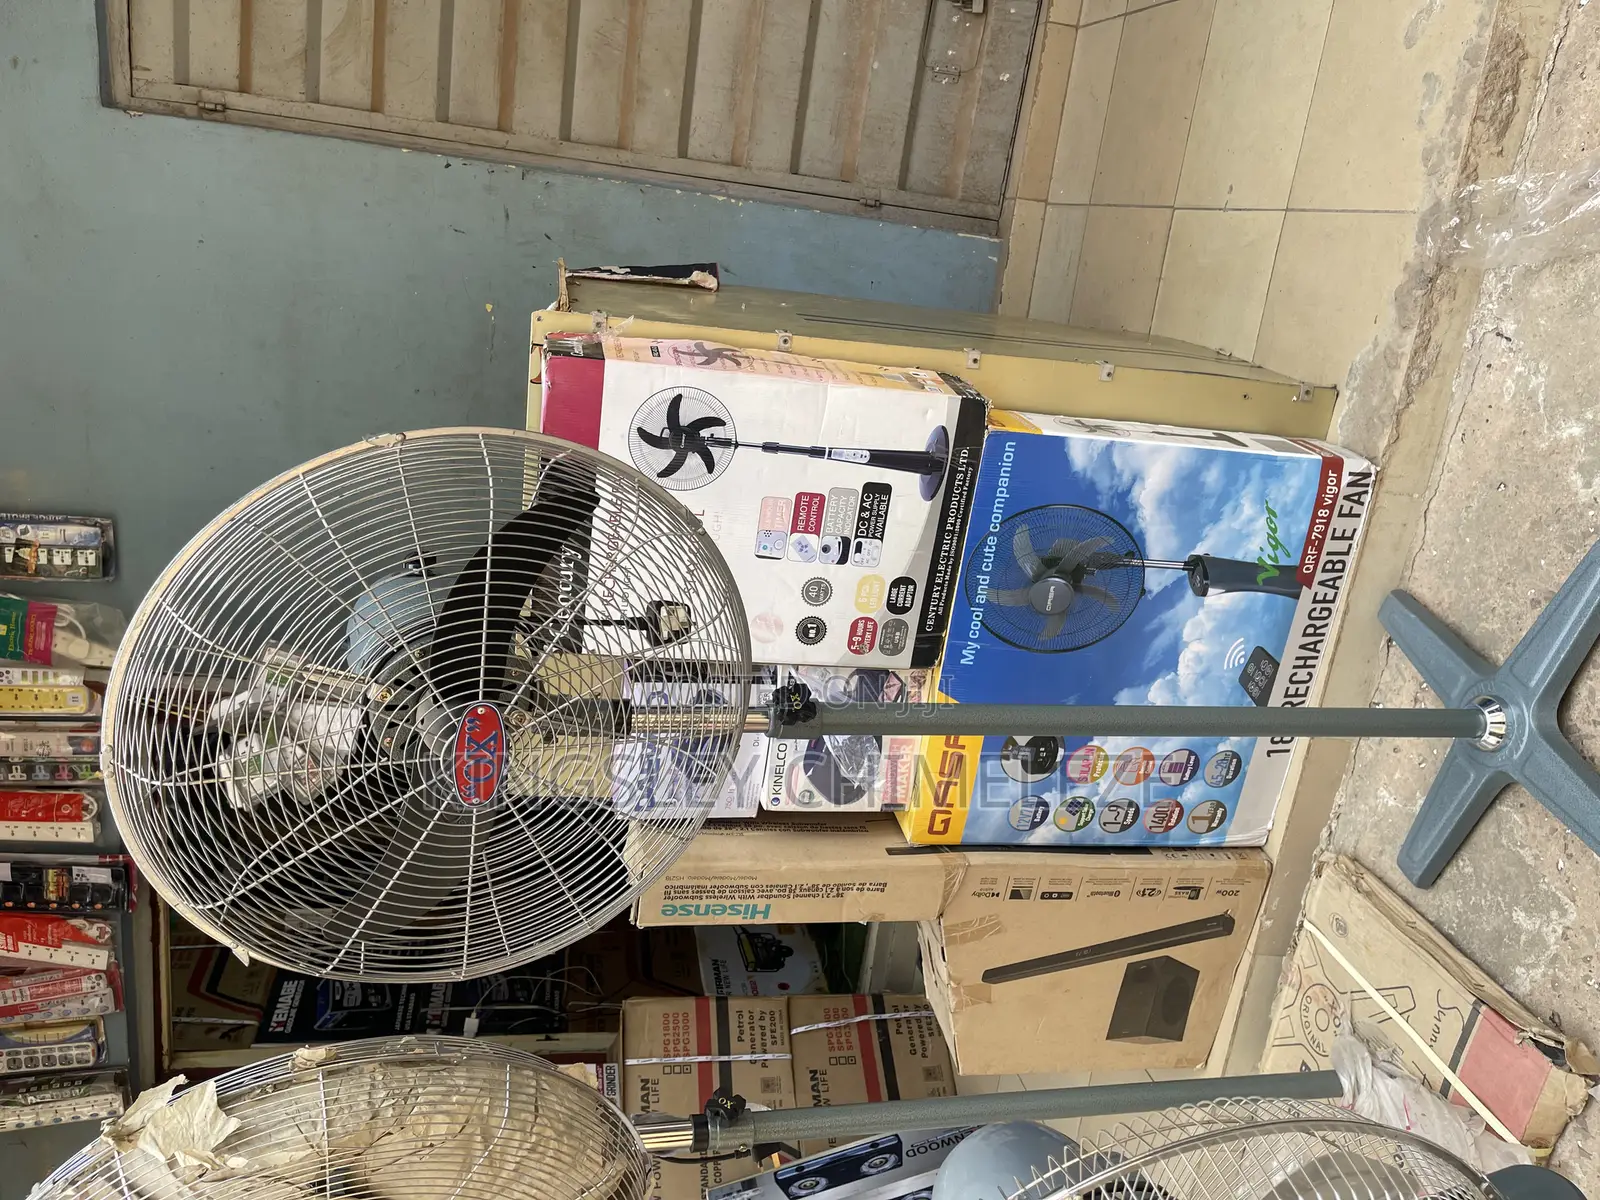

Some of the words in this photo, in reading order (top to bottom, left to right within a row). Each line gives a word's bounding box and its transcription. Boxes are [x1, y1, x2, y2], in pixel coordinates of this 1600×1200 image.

[961, 467, 973, 490] Factory
[989, 441, 1017, 532] companion
[797, 495, 810, 531] REMOTE
[808, 496, 820, 532] CONTROL
[825, 495, 838, 533] BATTERY
[835, 495, 847, 534] CAPACITY
[844, 496, 856, 535] INDICATOR
[860, 510, 870, 519] &
[863, 493, 873, 509] AC
[871, 493, 880, 516] SUPPLY
[957, 489, 967, 518] Certified
[857, 520, 868, 536] DC
[868, 516, 876, 537] POWER
[875, 494, 889, 539] AVAILABLE
[1302, 508, 1330, 575] QRF-7918
[1322, 469, 1340, 506] vigor
[925, 585, 942, 632] CENTURY
[935, 532, 952, 584] ELECTRIC
[946, 473, 964, 531] PRODUCTS
[957, 446, 970, 472] LTD.
[981, 535, 998, 572] cute
[1255, 499, 1291, 586] Vigor
[948, 557, 954, 565] by
[808, 586, 819, 598] 40
[818, 583, 826, 602] WATTS
[889, 587, 899, 604] LARGE
[896, 584, 907, 607] CURRENT
[904, 584, 915, 608] ADAPTOR
[939, 581, 949, 607] Products
[974, 574, 991, 605] and
[1046, 585, 1056, 612] QASA
[1280, 527, 1358, 708] RECHARGEABLE
[1336, 470, 1373, 519] FAN
[856, 620, 866, 636] HOURS
[866, 620, 875, 632] LIFE
[967, 606, 985, 640] cool
[960, 642, 980, 666] My
[771, 742, 788, 796] KINELCO
[897, 743, 913, 800] MAKER
[1183, 766, 1194, 781] Battery
[1188, 754, 1197, 766] Level
[1226, 758, 1238, 779] Duration
[1033, 806, 1046, 823] Battery
[1102, 803, 1126, 828] 1~9
[1123, 807, 1136, 825] Speeds
[1166, 807, 1181, 827] Rotation
[1191, 815, 1213, 825] 1
[1210, 807, 1225, 828] Warranty
[663, 890, 672, 898] fil
[757, 893, 791, 901] Soundbar
[971, 890, 992, 899] Dolby
[659, 903, 772, 920] Hisense
[711, 958, 726, 996] FIRMAN
[736, 1010, 745, 1043] Petrol
[758, 1010, 767, 1021] by
[769, 1010, 778, 1046] SFE200
[824, 1007, 836, 1053] SPG100
[832, 1007, 845, 1053] SPG200
[841, 1007, 854, 1052] SPG300
[892, 1004, 903, 1036] Petol
[903, 1004, 917, 1056] Generaor
[923, 1003, 935, 1037] SFE20
[1303, 994, 1328, 1055] ORIGINAL
[662, 1013, 671, 1058] SPG1800
[672, 1012, 681, 1057] SPG2500
[682, 1011, 690, 1057] SPG3000
[748, 1009, 757, 1065] Generator
[758, 1025, 769, 1068] Pwered
[915, 1018, 929, 1059] Powered
[605, 1064, 617, 1097] GRINDER
[652, 1078, 660, 1103] LIFE
[819, 1069, 830, 1094] LIFE
